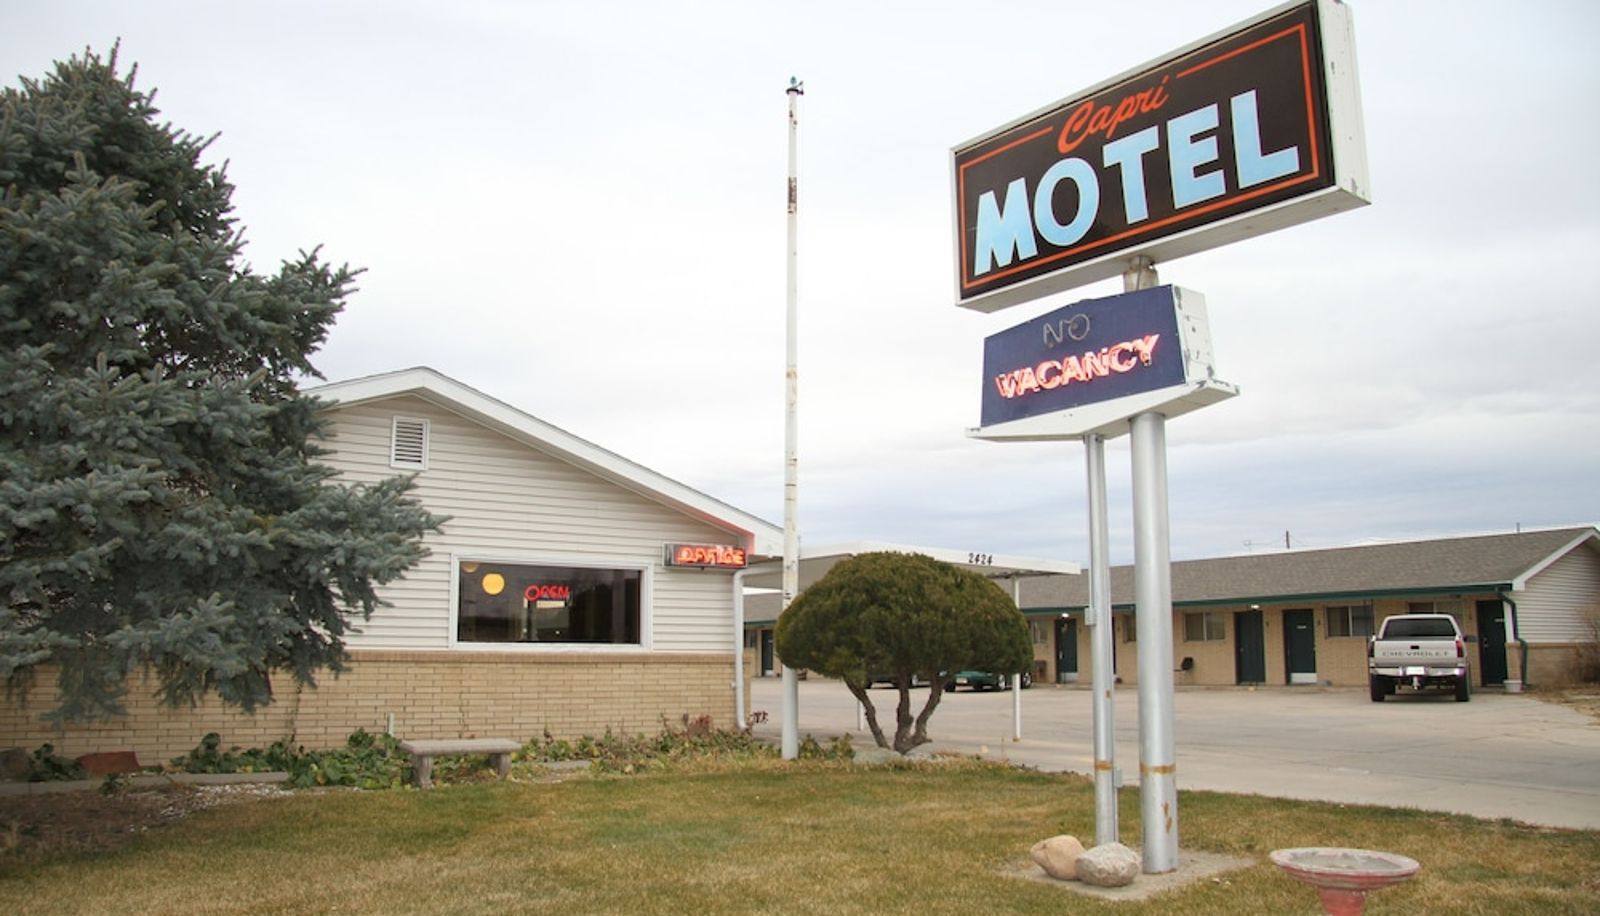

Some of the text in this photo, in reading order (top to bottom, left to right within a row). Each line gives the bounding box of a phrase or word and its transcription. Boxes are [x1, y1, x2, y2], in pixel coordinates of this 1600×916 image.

[1057, 75, 1170, 154] Capri
[974, 89, 1300, 276] MOTEL
[1043, 313, 1090, 344] NO
[995, 334, 1160, 398] VACANCY
[968, 552, 993, 567] 2424
